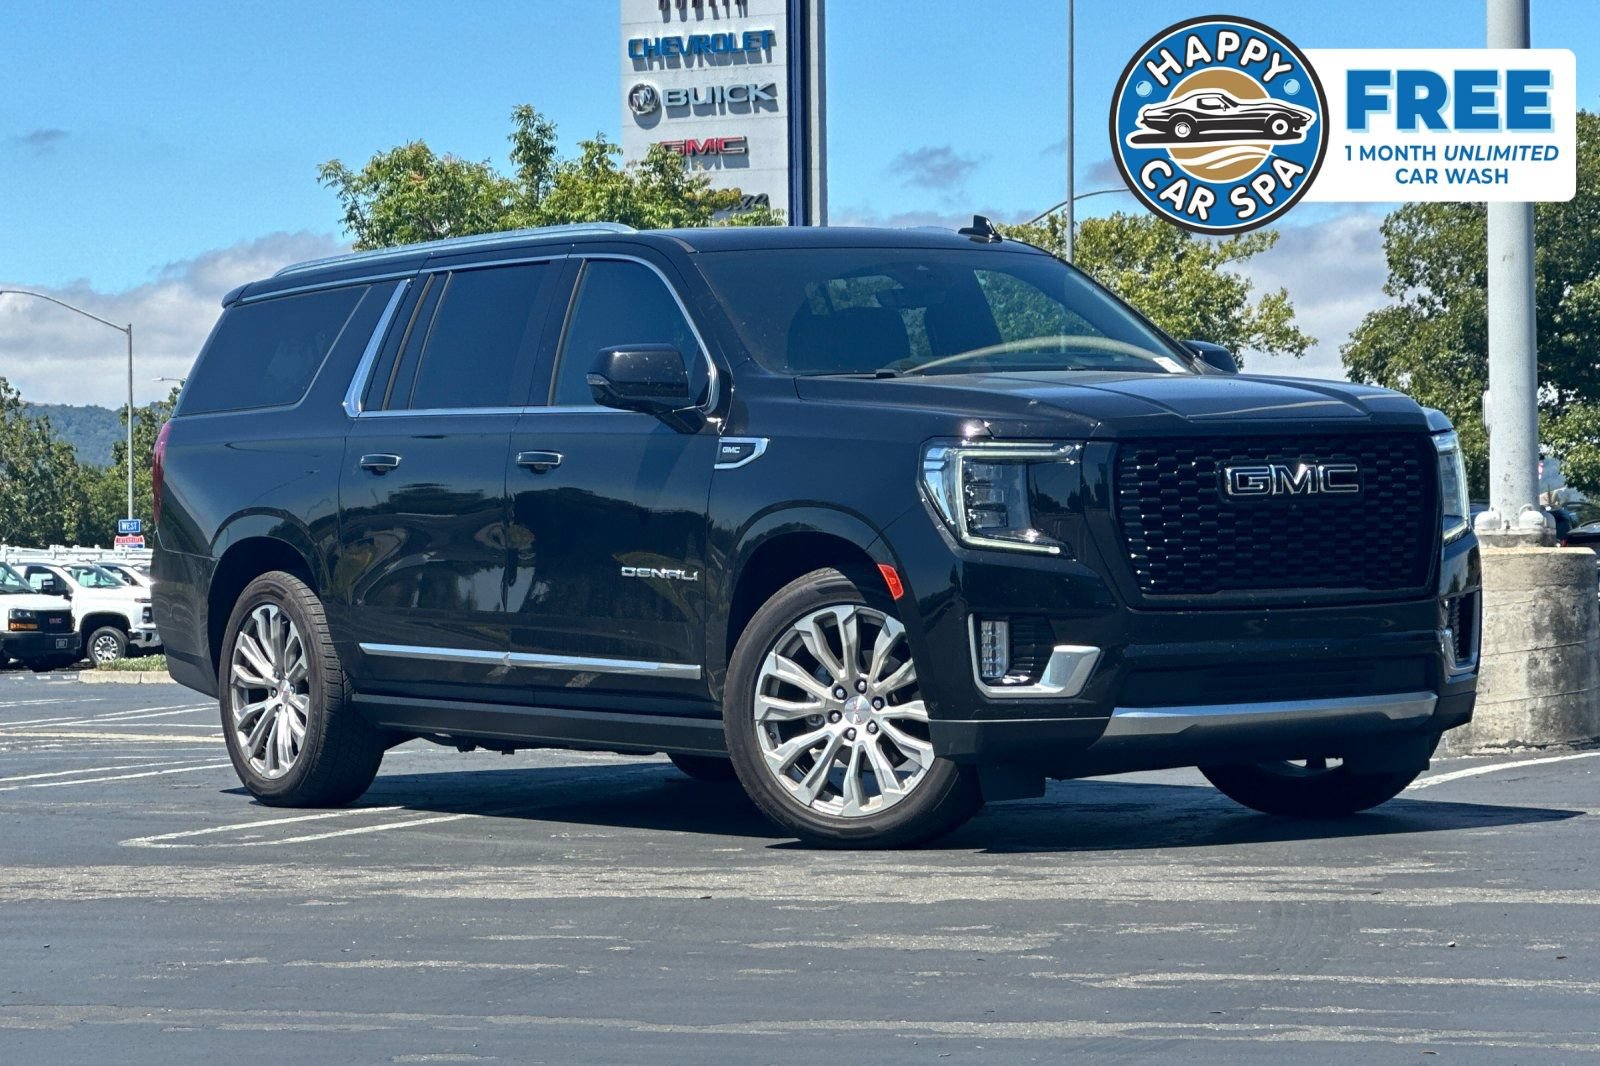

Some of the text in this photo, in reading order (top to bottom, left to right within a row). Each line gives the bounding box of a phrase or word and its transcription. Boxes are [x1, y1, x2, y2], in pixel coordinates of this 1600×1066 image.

[628, 30, 775, 59] CHEVROLET
[662, 83, 777, 106] BUICK
[659, 136, 747, 157] GMC
[1224, 463, 1359, 496] GMC
[121, 521, 138, 530] WEST
[621, 566, 699, 581] DENALI
